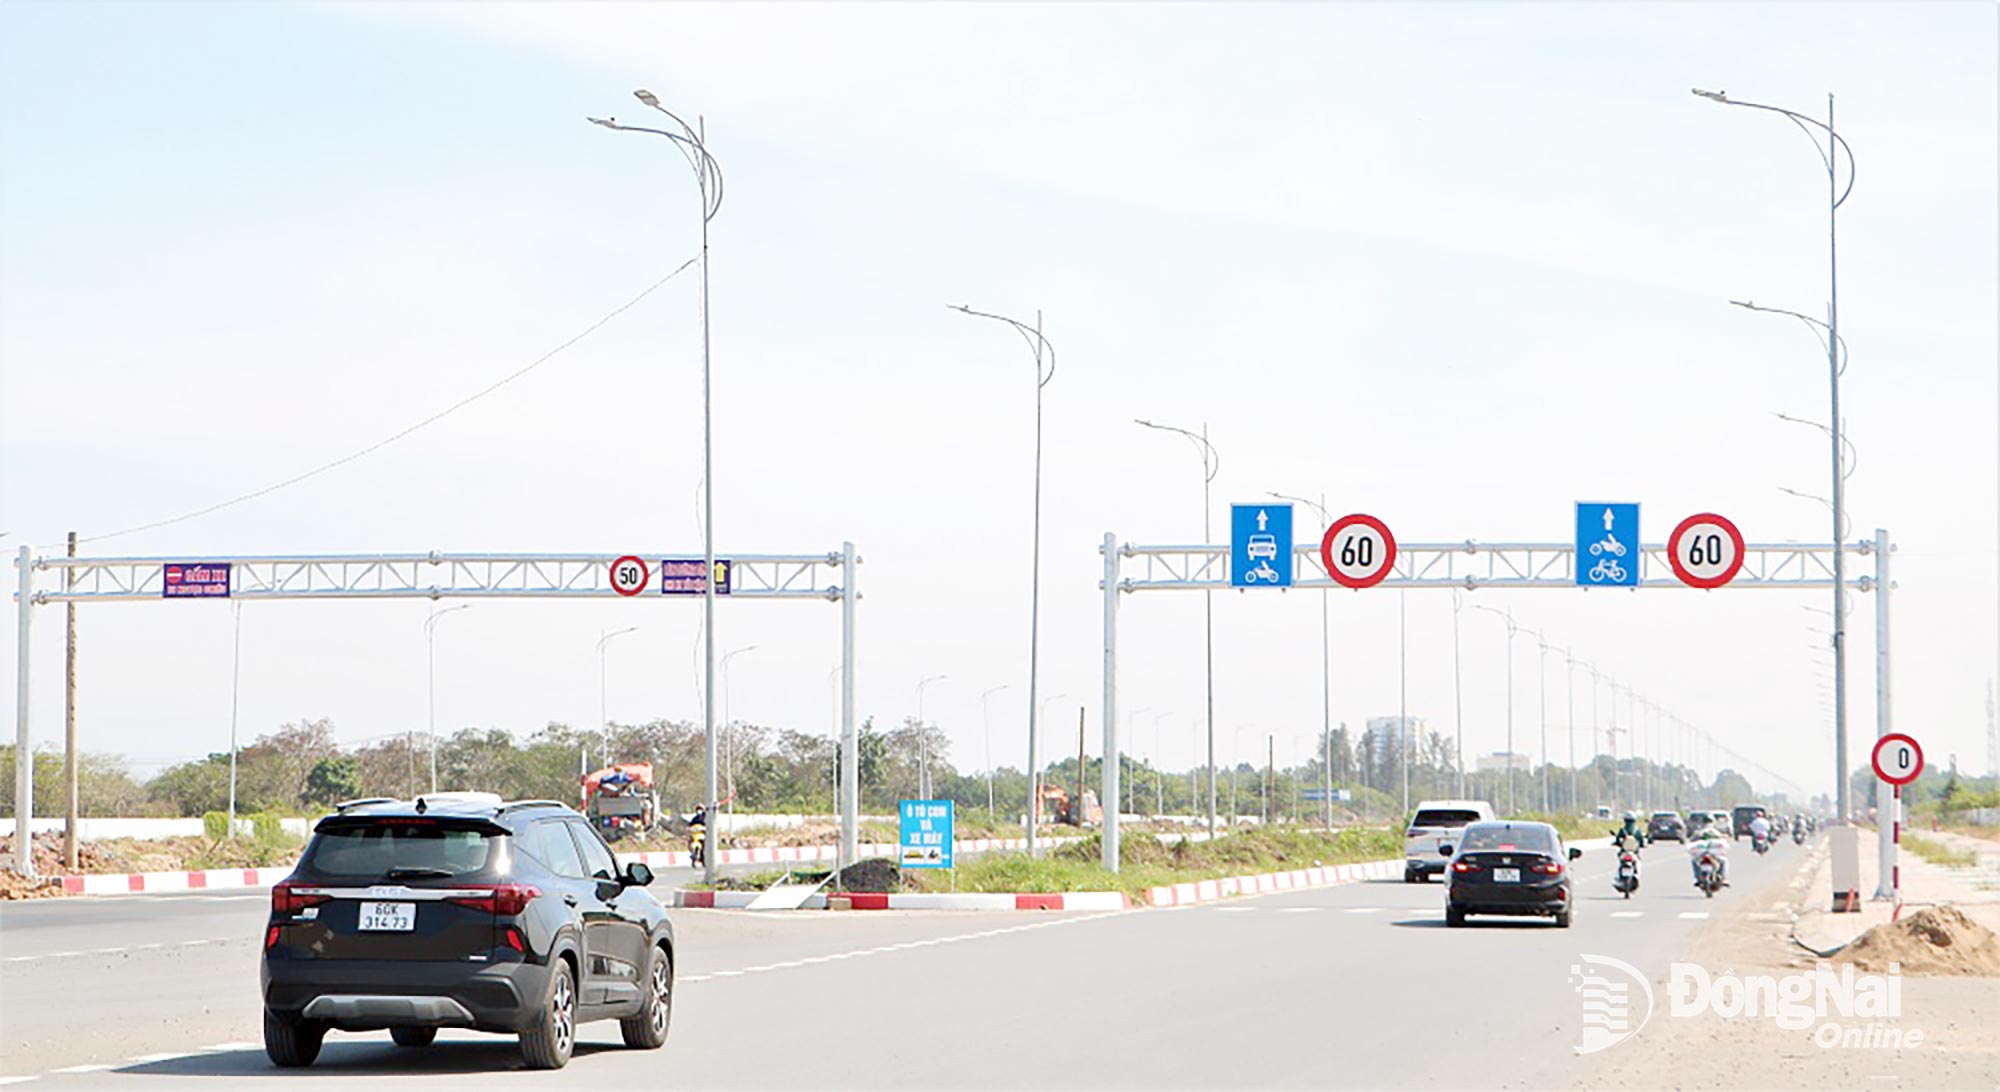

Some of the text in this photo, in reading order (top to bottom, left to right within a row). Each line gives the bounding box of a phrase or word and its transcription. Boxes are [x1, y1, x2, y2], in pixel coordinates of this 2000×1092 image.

[1341, 536, 1373, 567] 60
[1689, 534, 1721, 566] 60
[620, 567, 637, 585] 50
[375, 903, 399, 916] 60K
